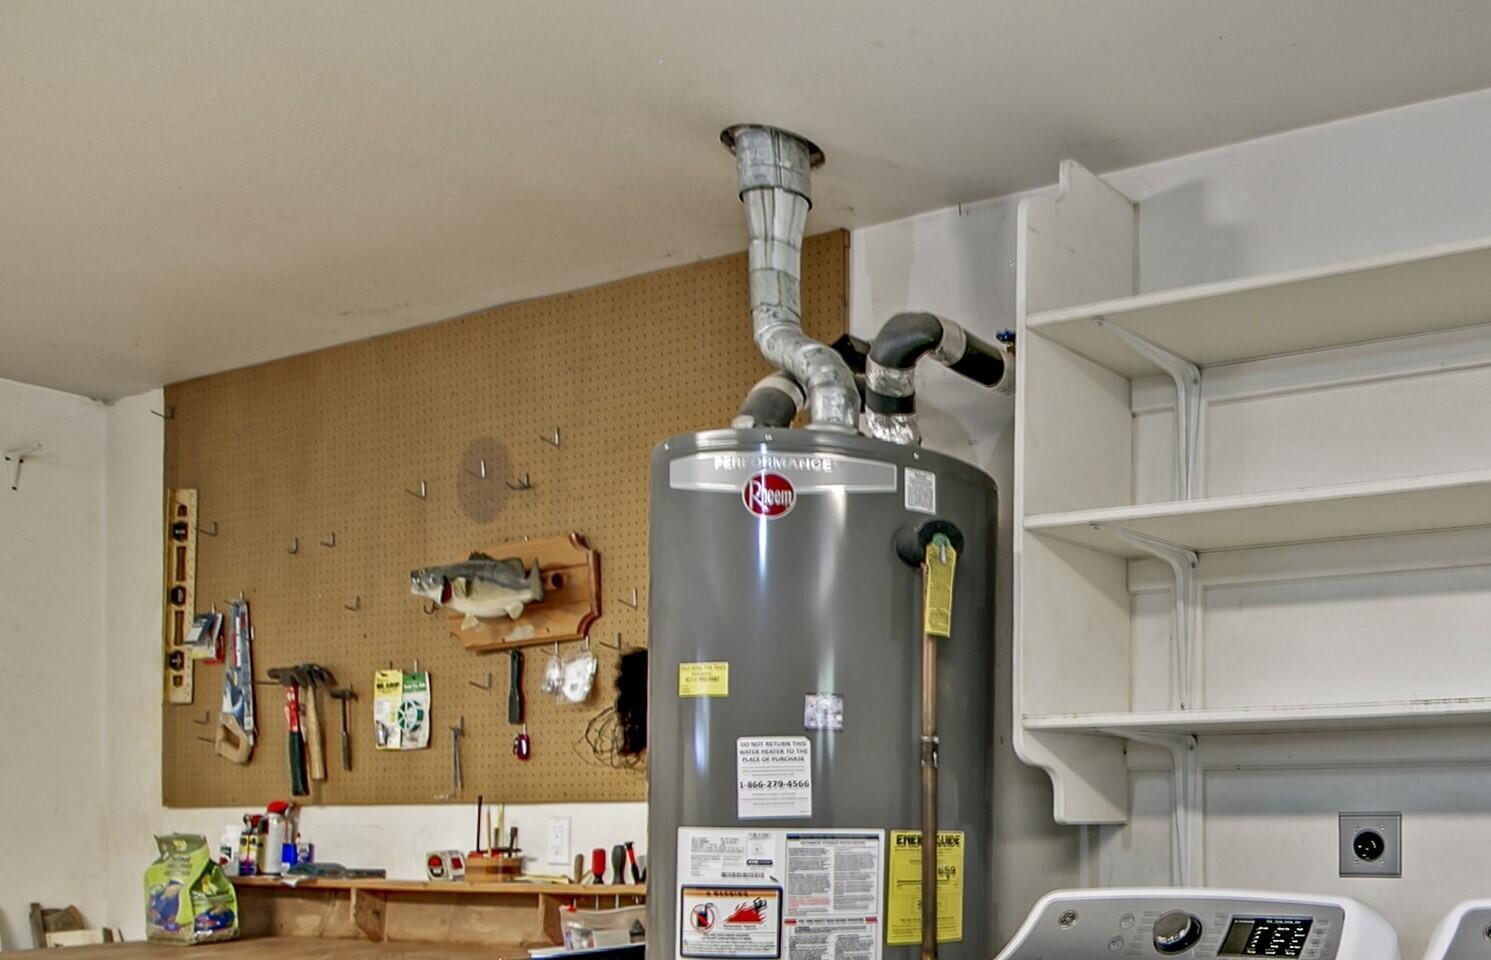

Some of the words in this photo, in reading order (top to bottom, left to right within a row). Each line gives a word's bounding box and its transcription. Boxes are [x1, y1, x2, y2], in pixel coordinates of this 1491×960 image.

[713, 455, 833, 472] PERFORMANCE
[749, 477, 793, 513] Rheem
[739, 780, 810, 789] 1-866-279-4566
